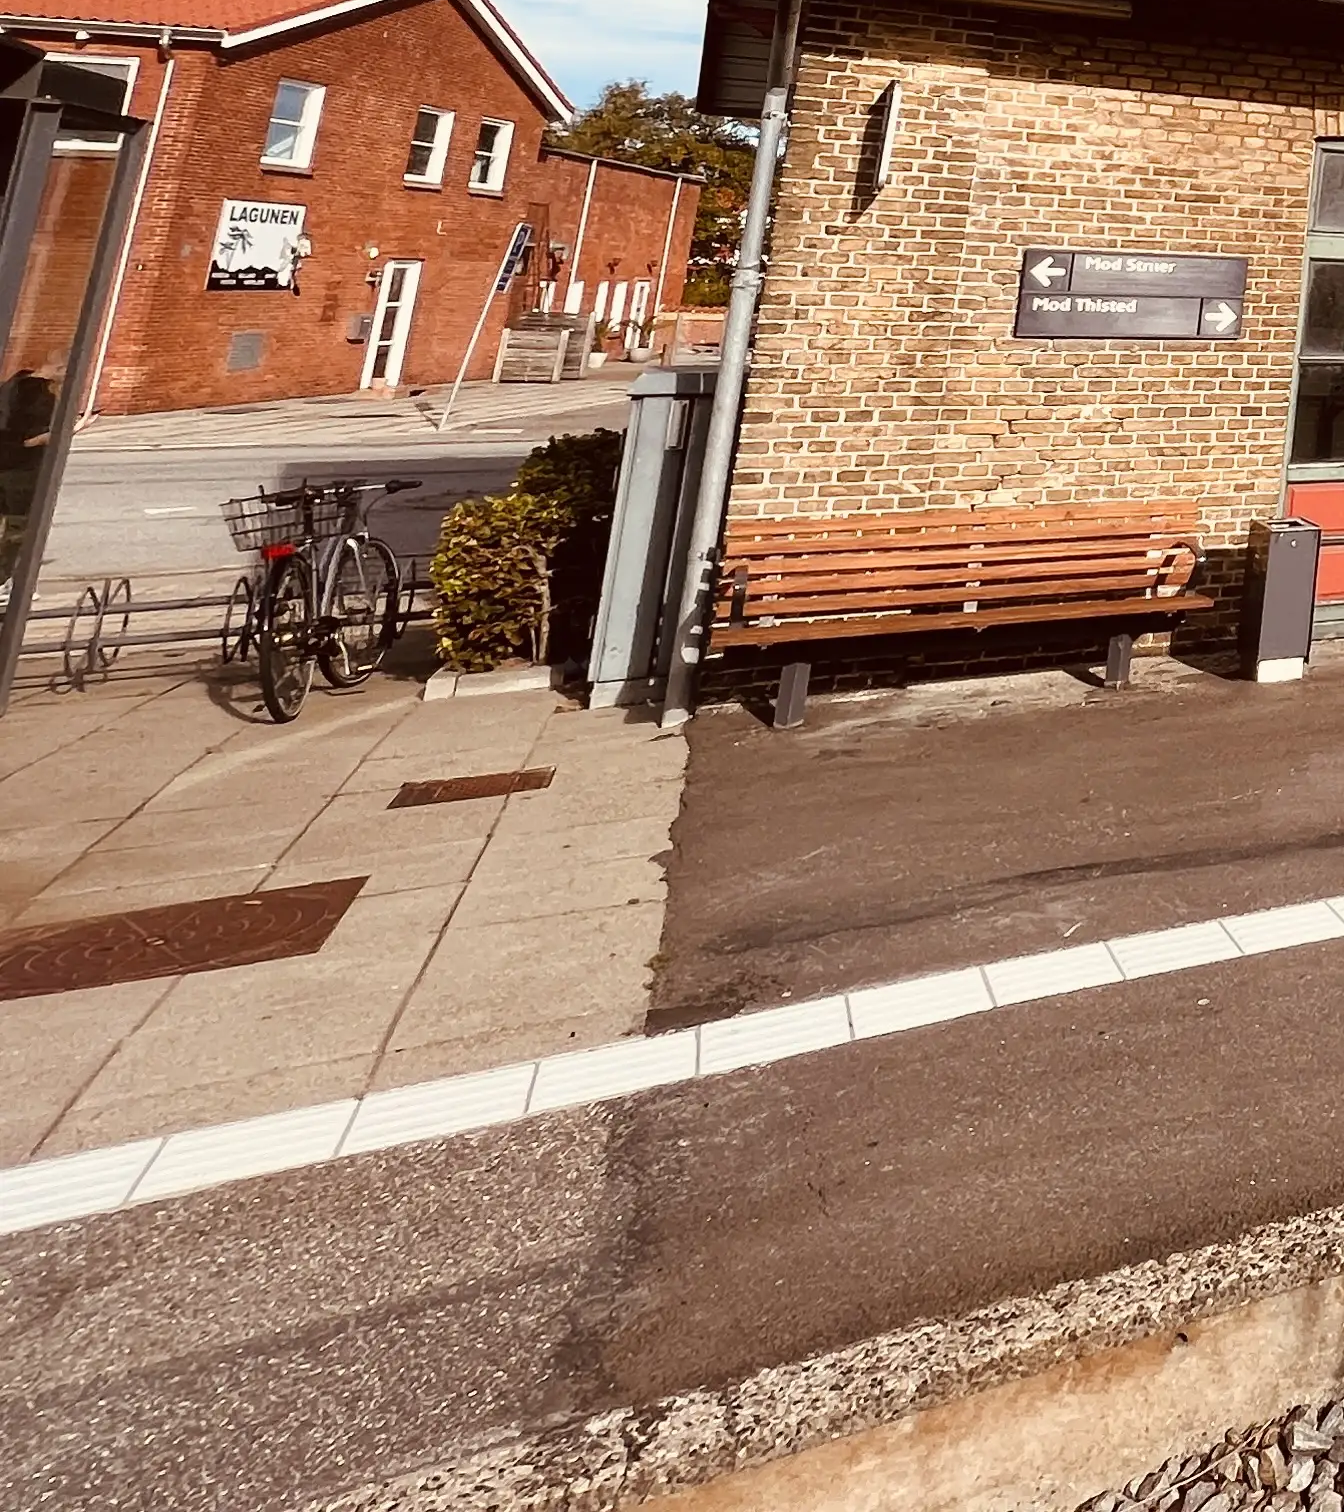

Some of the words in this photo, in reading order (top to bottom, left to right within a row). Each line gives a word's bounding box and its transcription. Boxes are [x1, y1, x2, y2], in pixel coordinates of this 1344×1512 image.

[229, 206, 300, 225] LAGUNEN
[1085, 256, 1122, 271] Mod
[1032, 297, 1072, 312] Mod
[1075, 298, 1138, 313] Thisted
